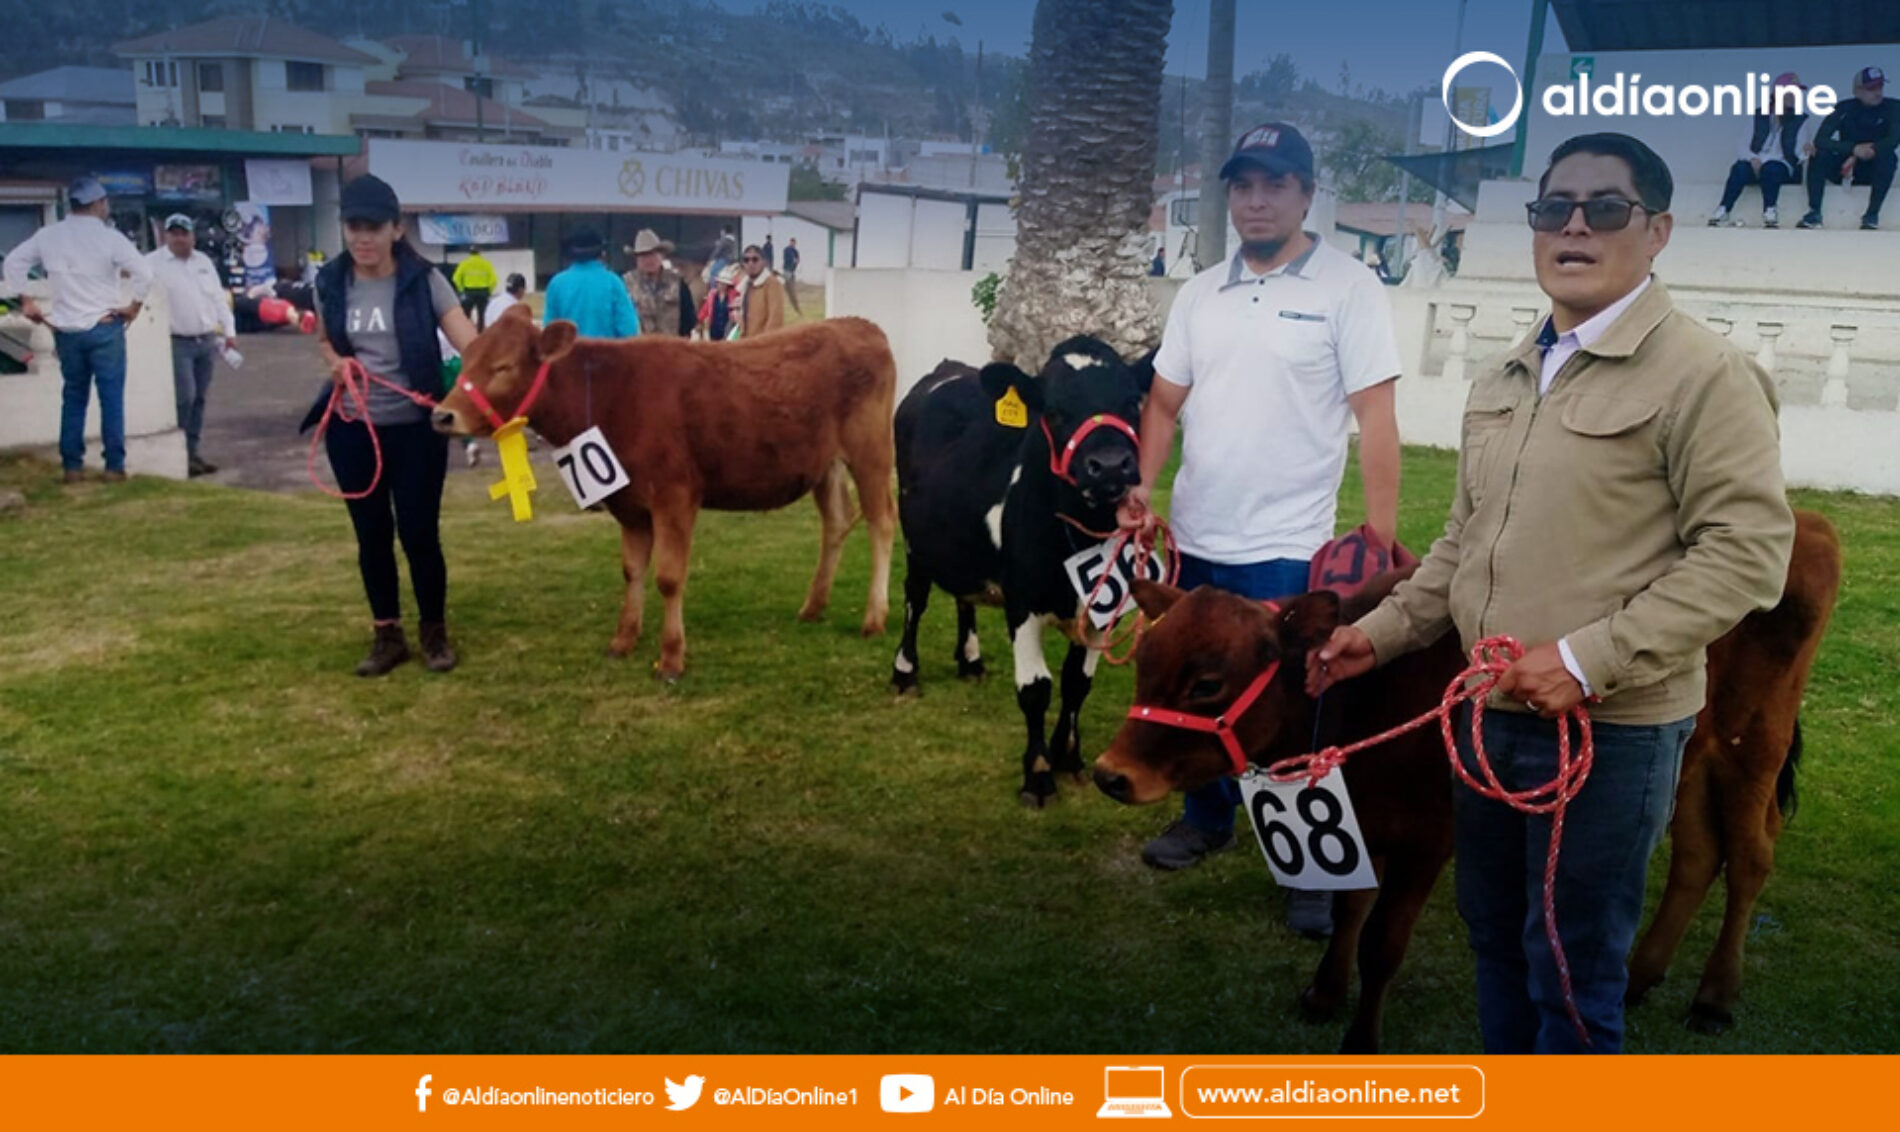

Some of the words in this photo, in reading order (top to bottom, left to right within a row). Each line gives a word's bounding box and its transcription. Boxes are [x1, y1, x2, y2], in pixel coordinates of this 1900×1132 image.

[655, 165, 745, 201] CHIVAS
[556, 440, 617, 500] 70
[1076, 534, 1161, 614] 56
[1251, 786, 1360, 877] 68
